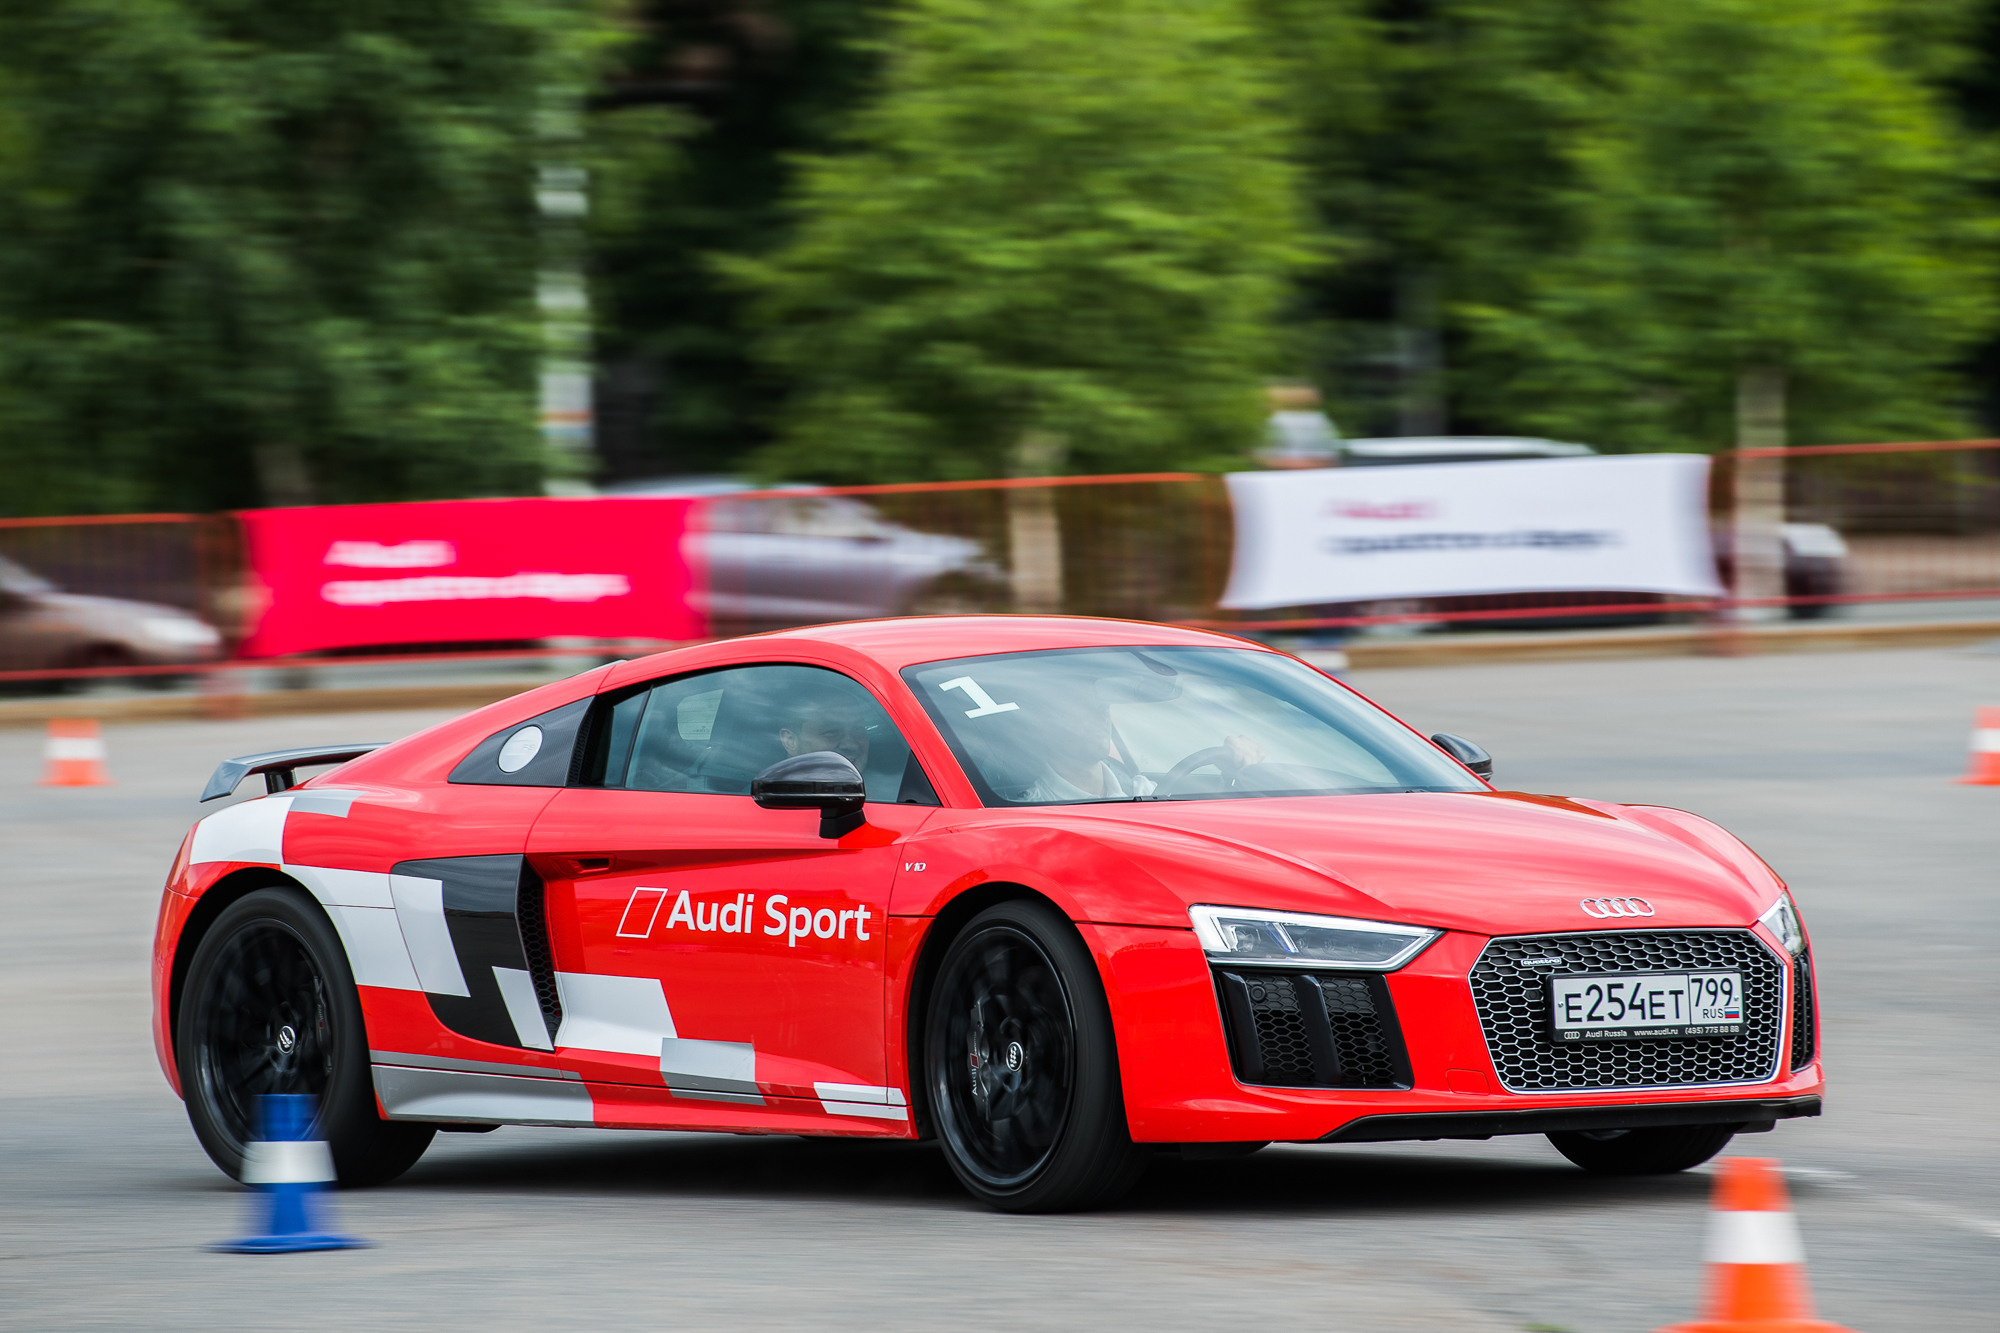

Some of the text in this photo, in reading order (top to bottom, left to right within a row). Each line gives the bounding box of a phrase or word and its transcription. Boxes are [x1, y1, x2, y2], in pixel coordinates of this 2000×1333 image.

[938, 676, 1020, 719] 1
[905, 862, 927, 872] V10
[666, 889, 872, 948] Audi Sport
[1565, 977, 1734, 1023] E254ET 799
[1702, 1008, 1724, 1019] RUS
[1585, 1030, 1603, 1038] Audi
[1634, 1028, 1679, 1037] www.audi.ru
[1685, 1026, 1704, 1035] (495)
[1705, 1026, 1718, 1034] 775
